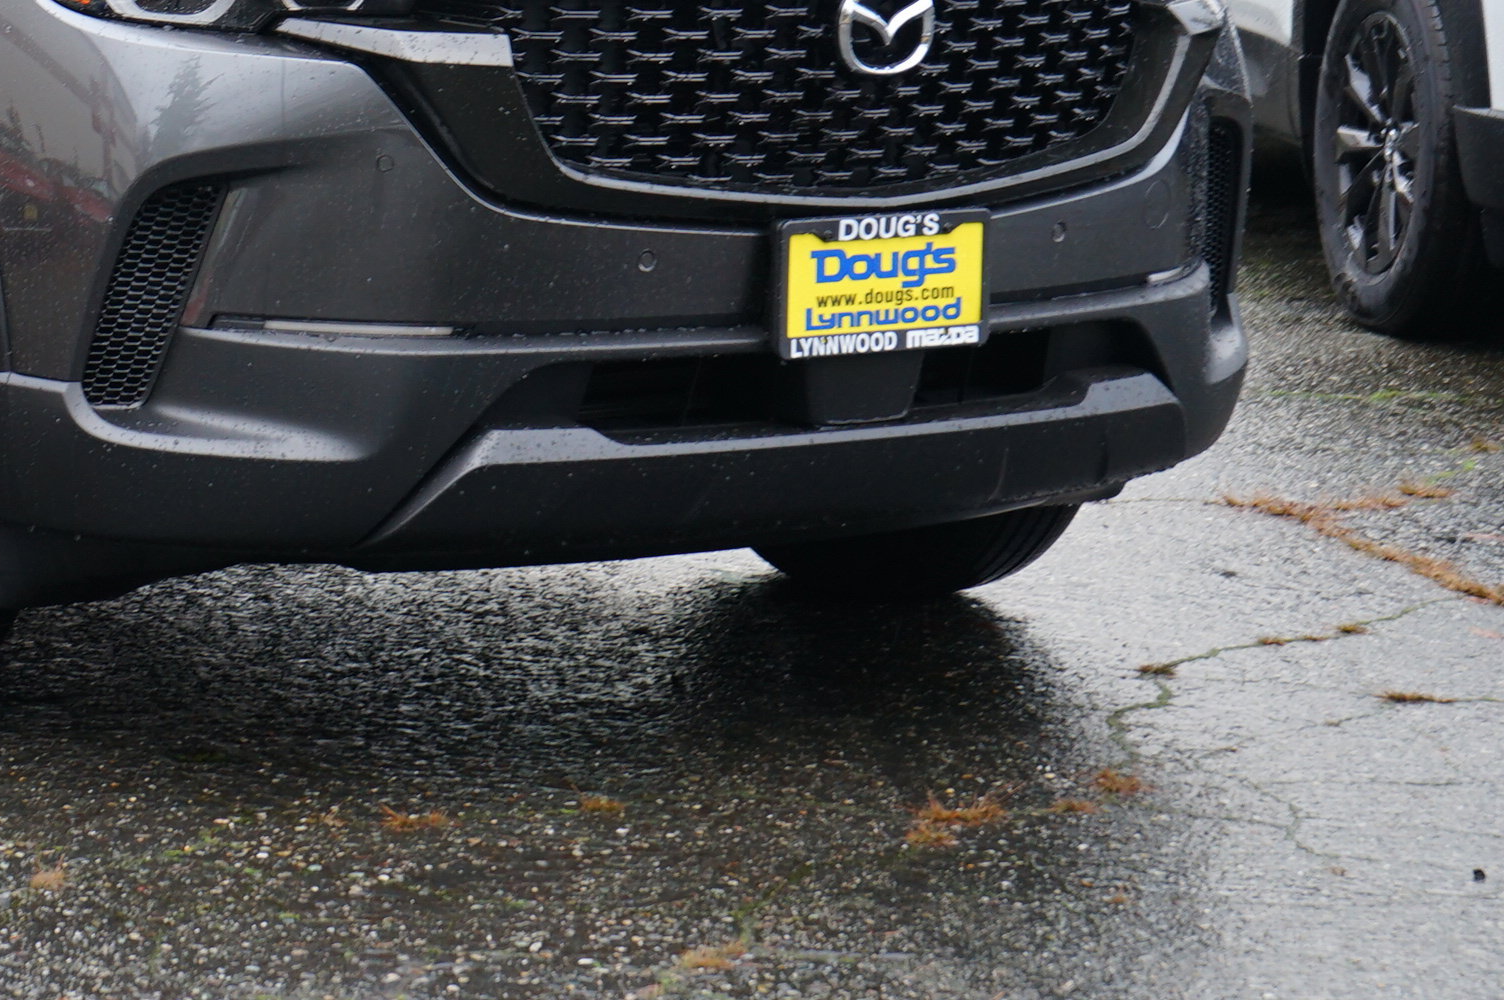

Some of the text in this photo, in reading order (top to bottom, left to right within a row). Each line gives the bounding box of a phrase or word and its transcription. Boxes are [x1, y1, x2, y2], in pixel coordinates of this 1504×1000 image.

[838, 213, 940, 241] DOUG'S
[816, 286, 955, 308] www.dougs.com
[805, 297, 962, 331] Lynnwood
[790, 331, 898, 359] LYNNWOOD
